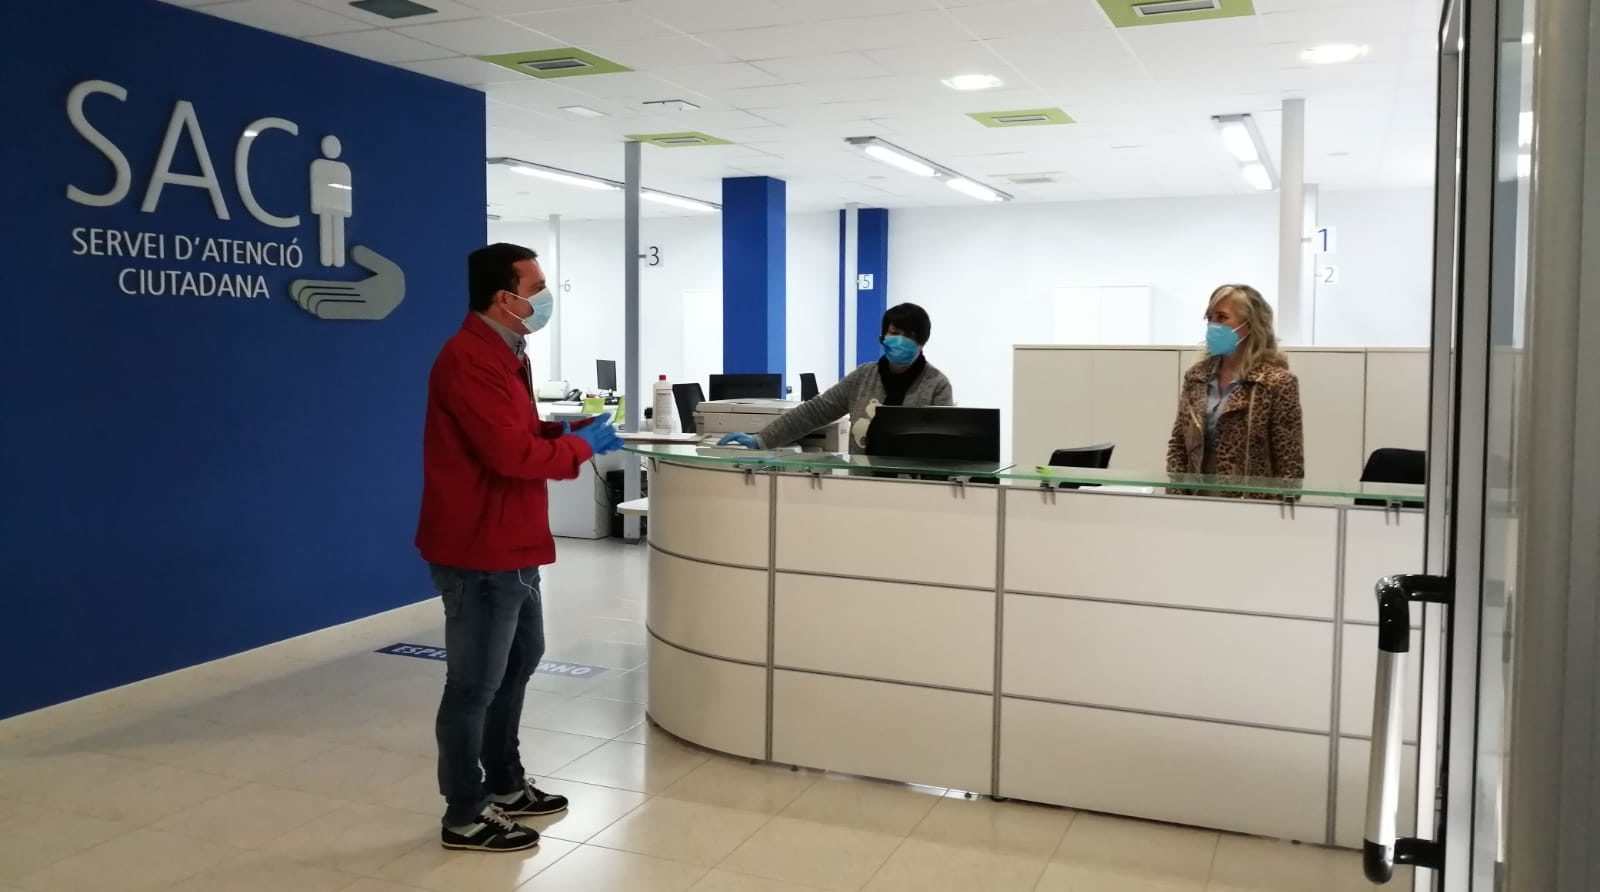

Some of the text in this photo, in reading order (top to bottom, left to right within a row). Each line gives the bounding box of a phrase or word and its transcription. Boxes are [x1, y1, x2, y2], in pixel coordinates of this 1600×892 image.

[72, 227, 304, 268] SERVEI D'ATENCIÓ
[1318, 228, 1328, 252] 1
[649, 246, 660, 266] 3
[118, 268, 270, 299] CIUTADANA
[564, 279, 571, 293] 6
[862, 274, 870, 289] 5
[1324, 266, 1335, 284] 2
[392, 645, 591, 675] ESPE RNO
